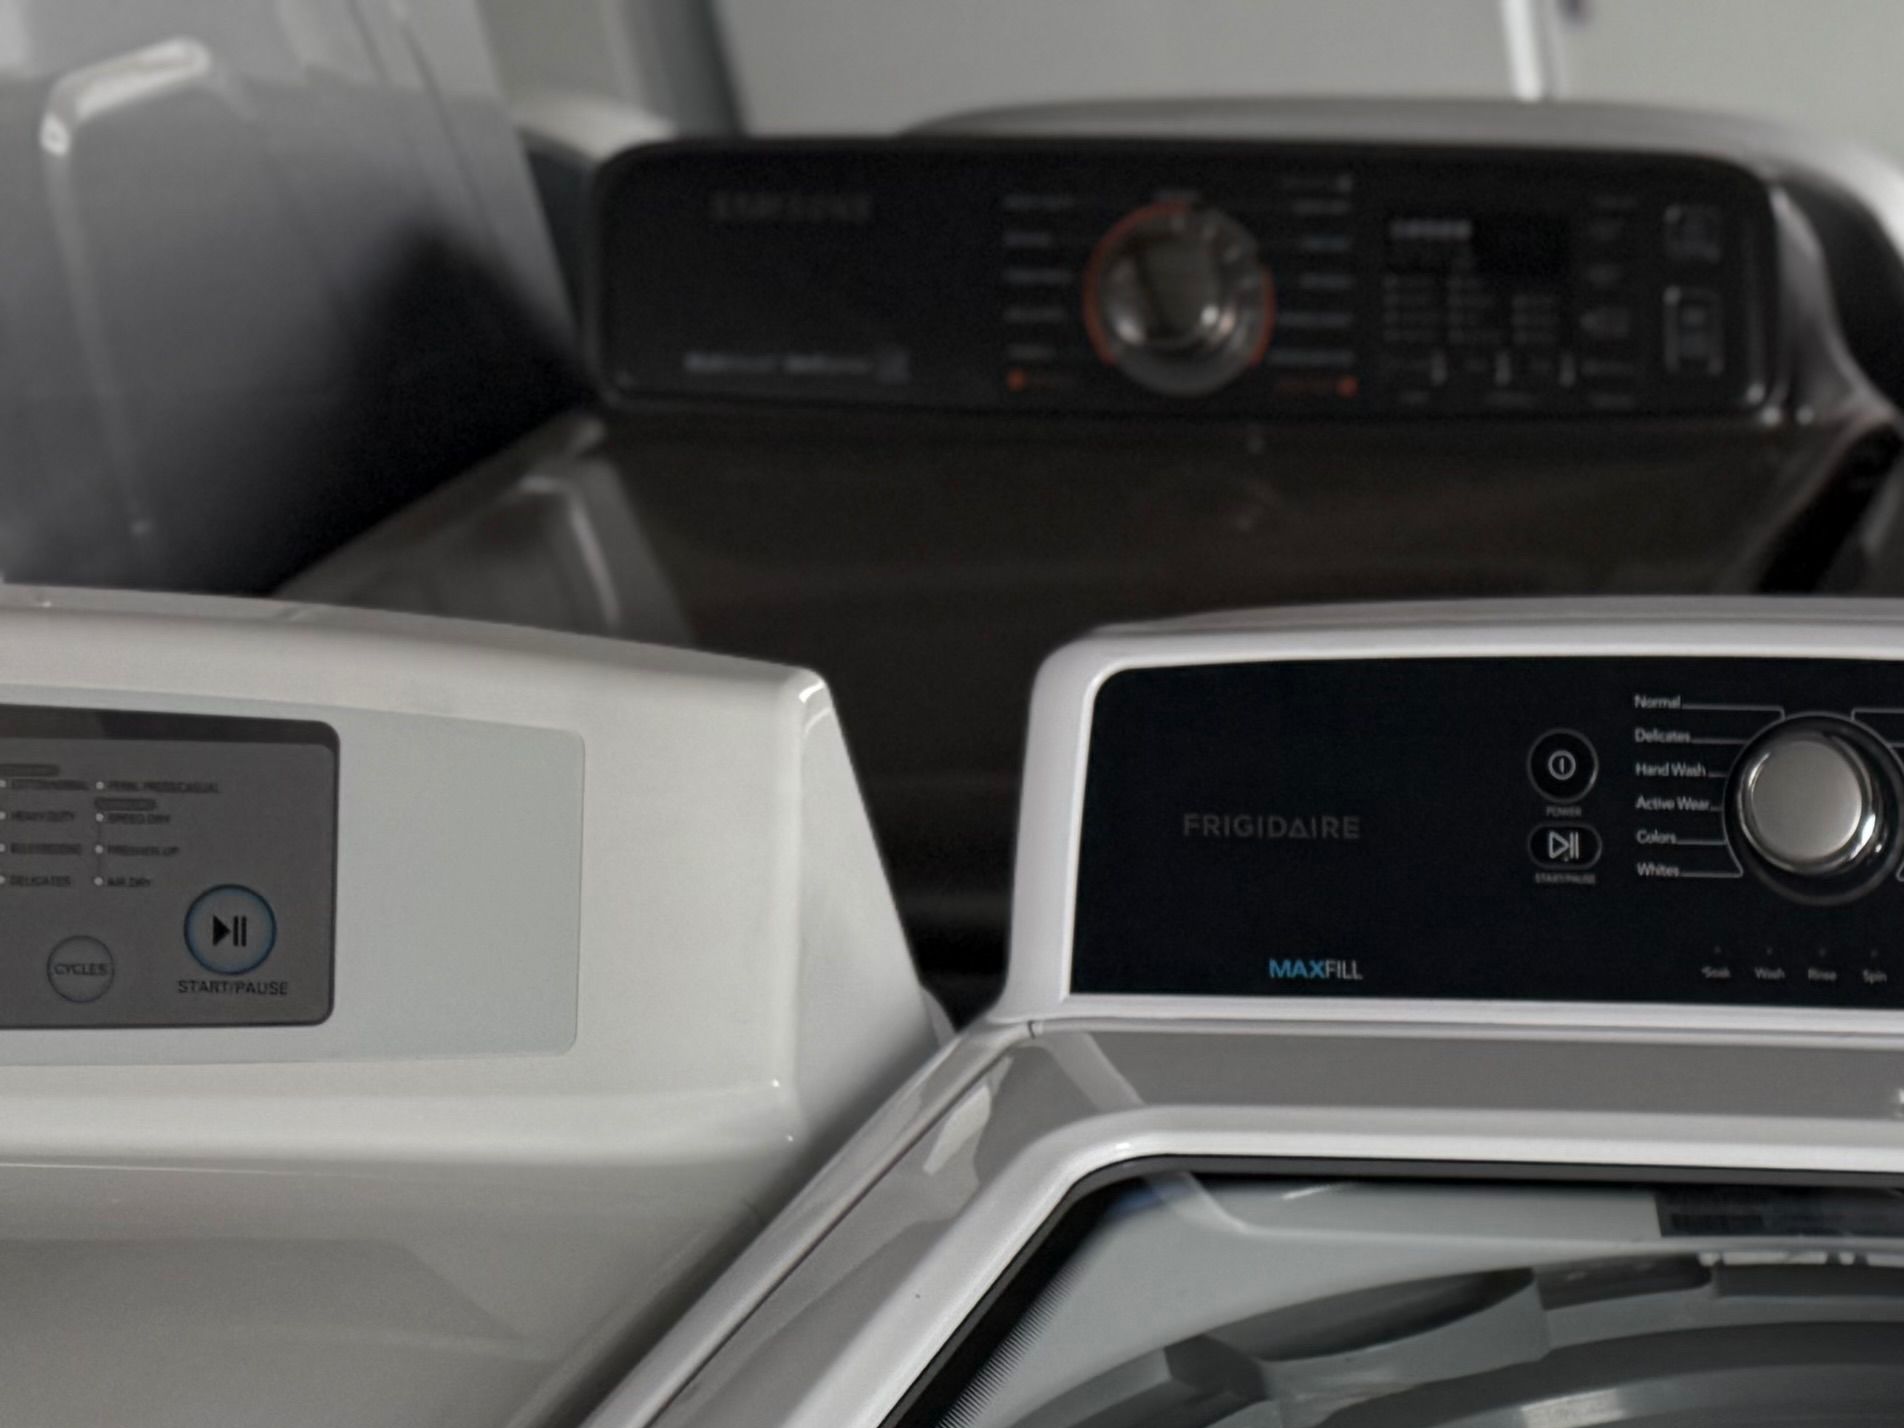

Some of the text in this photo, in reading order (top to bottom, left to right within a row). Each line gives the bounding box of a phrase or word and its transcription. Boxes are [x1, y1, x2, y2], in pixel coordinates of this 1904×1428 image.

[1634, 695, 1681, 709] Normal
[1635, 728, 1690, 743] Delicates
[1635, 763, 1706, 777] Hand Wash
[1635, 796, 1709, 811] Active Wear
[1182, 812, 1361, 839] FRIGIDAIRE
[1636, 830, 1676, 844] Colors
[1637, 863, 1679, 877] Whites
[54, 963, 108, 976] CYCLES
[1268, 958, 1363, 980] MAXFILL
[178, 980, 288, 996] START/PAUSE
